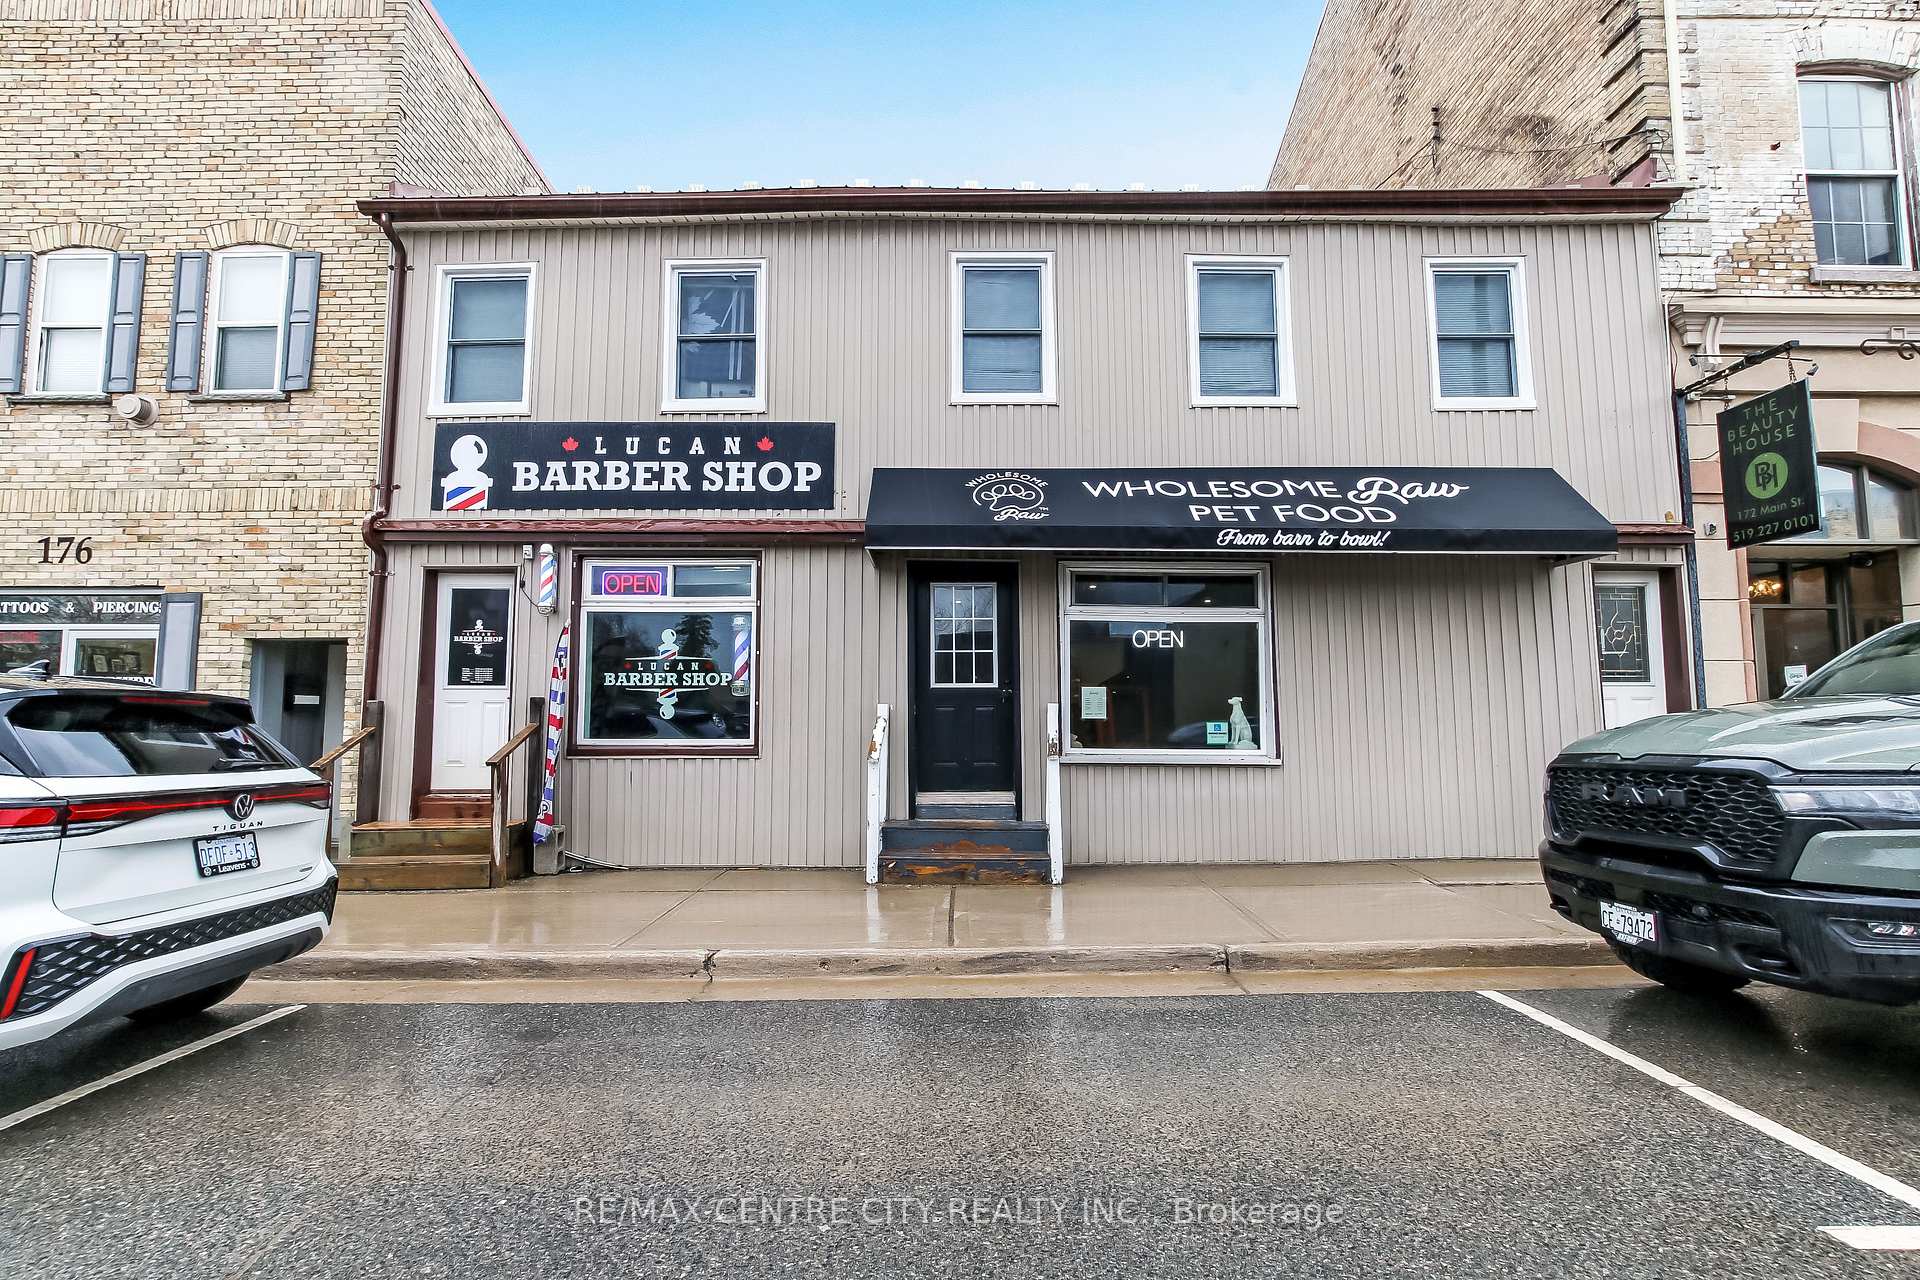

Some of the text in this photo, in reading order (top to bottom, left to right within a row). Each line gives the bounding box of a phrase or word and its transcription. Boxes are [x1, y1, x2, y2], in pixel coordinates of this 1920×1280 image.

[1743, 398, 1778, 420] THE
[1727, 406, 1798, 442] BEAUTY
[594, 436, 742, 456] LUCAN
[1732, 423, 1796, 456] HOUSE
[511, 461, 822, 493] BARBER SHOP
[964, 471, 1049, 488] WHOLESOME
[1081, 476, 1470, 505] WHOLESOME Raw
[993, 508, 1051, 522] Raw
[1188, 503, 1397, 523] PET FOOD
[1736, 507, 1756, 521] 172
[1760, 500, 1788, 516] Main
[1216, 528, 1392, 547] From barn to bowl!
[36, 536, 94, 565] 176
[604, 574, 660, 594] OPEN
[0, 601, 162, 614] TTOOS & PIERCING
[1131, 629, 1184, 649] OPEN
[637, 661, 700, 671] LUCAN
[603, 672, 734, 686] BARBER SHOP
[212, 820, 264, 832] TIGUAN
[218, 862, 247, 873] Leavens
